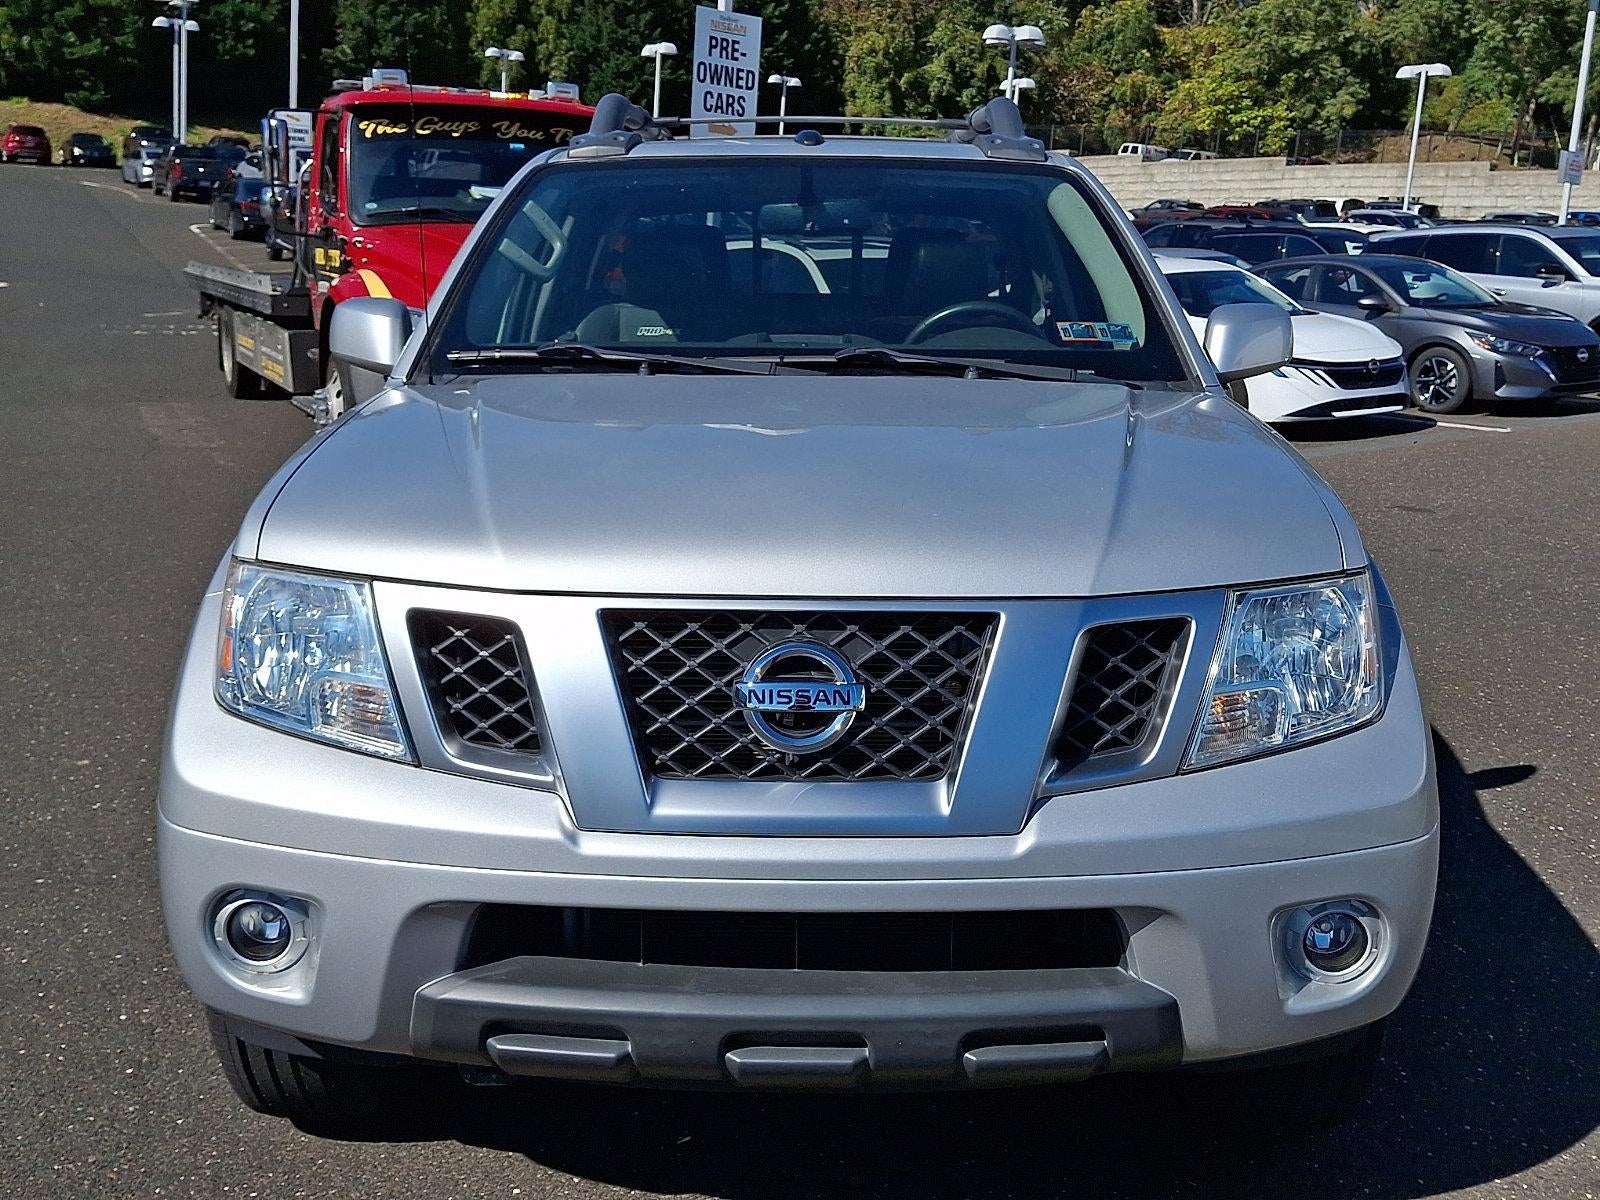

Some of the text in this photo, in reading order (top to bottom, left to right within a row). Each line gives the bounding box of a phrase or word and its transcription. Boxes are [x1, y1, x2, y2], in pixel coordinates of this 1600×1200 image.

[708, 35, 747, 61] PRE-
[696, 61, 756, 91] OWNED
[703, 91, 747, 118] CARS
[358, 119, 409, 139] The
[415, 116, 481, 137] Guys
[492, 120, 546, 141] You
[747, 688, 851, 706] NISSAN
